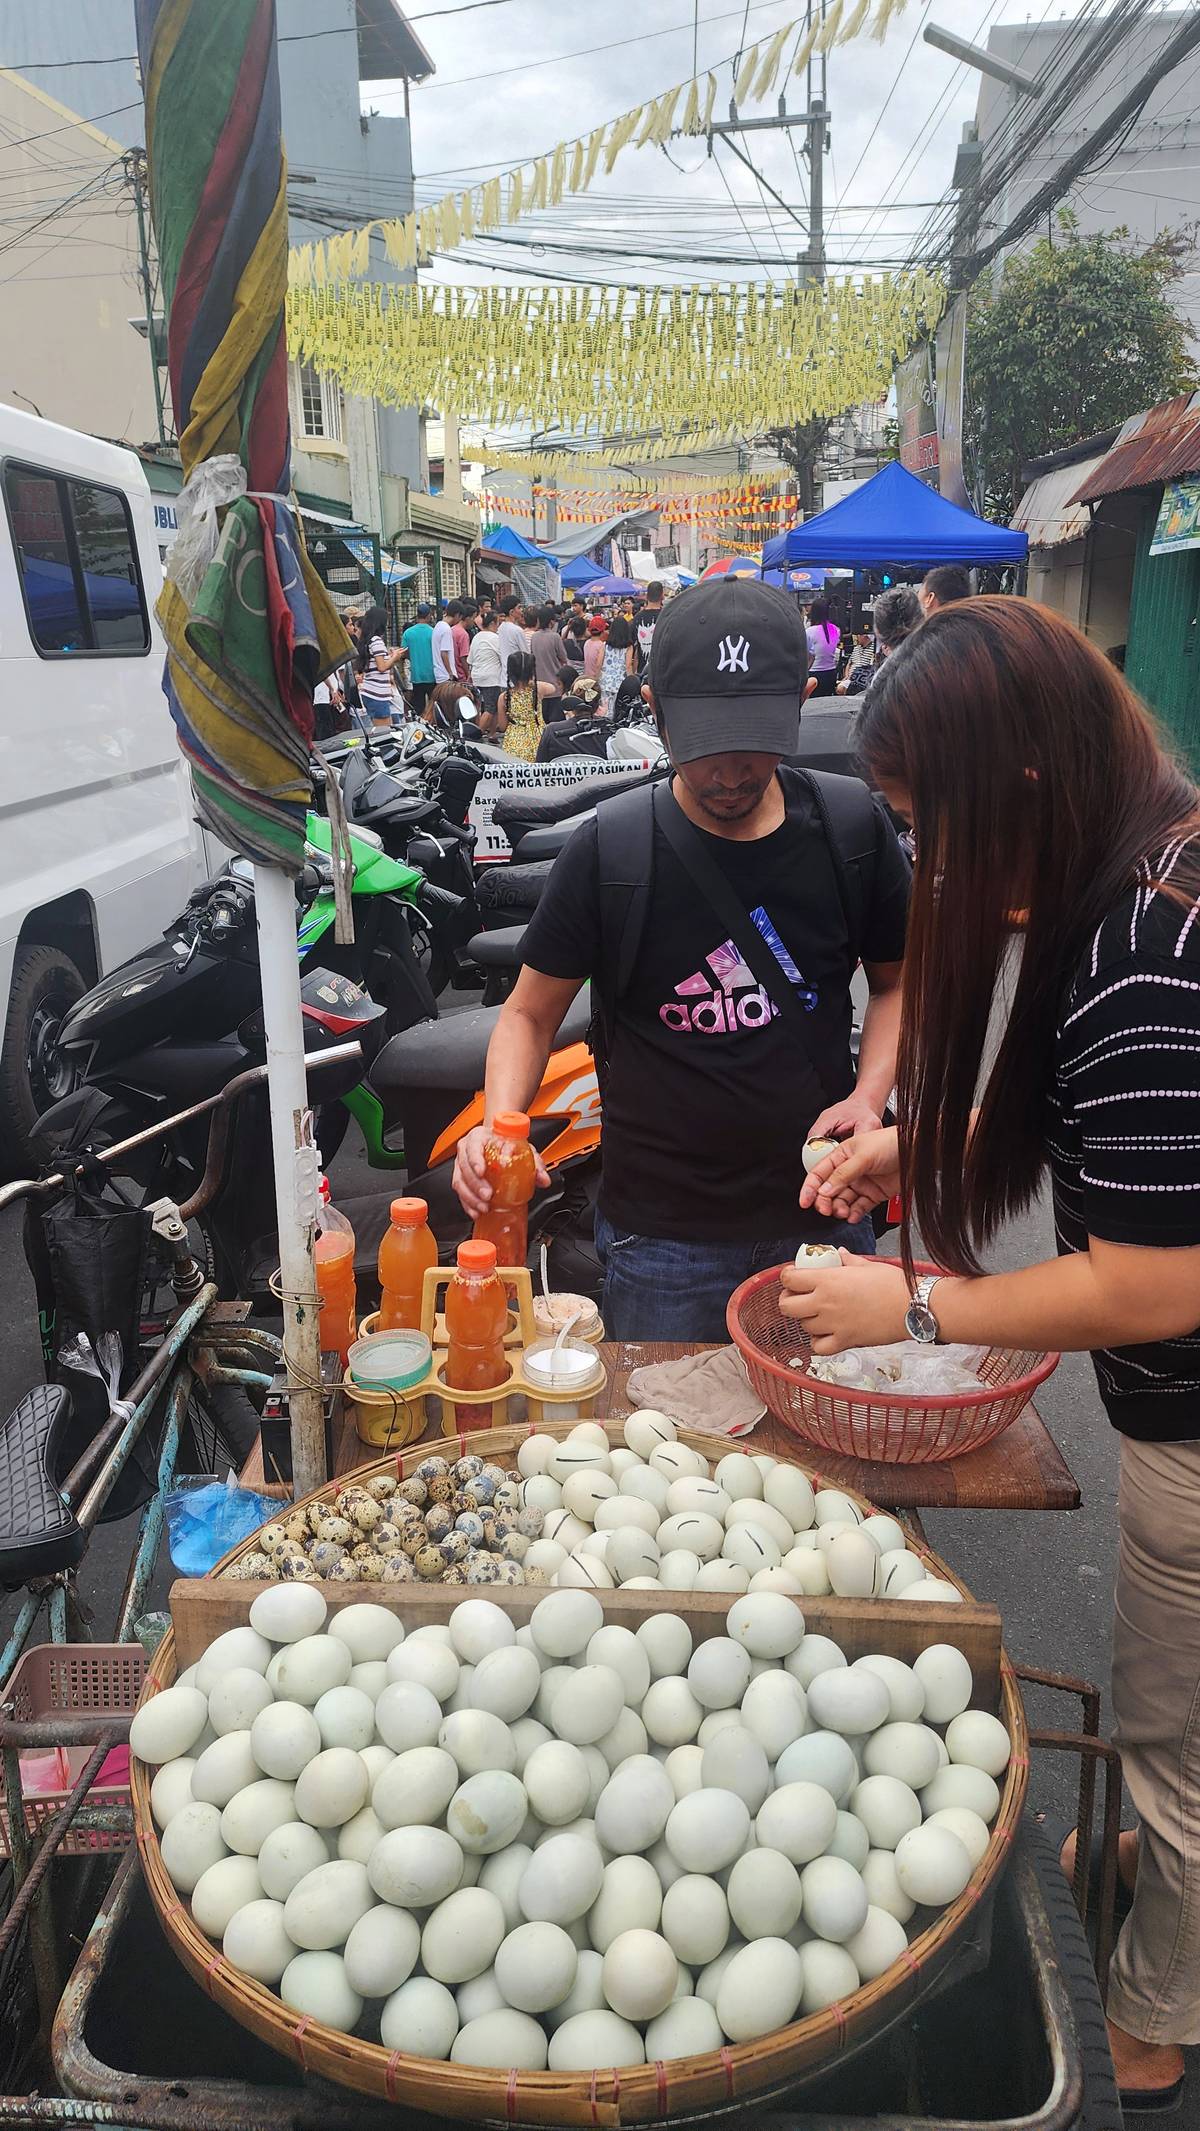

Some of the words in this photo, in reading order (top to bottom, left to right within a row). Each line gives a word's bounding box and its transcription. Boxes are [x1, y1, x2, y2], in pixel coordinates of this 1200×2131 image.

[357, 298, 365, 330] CAUTION
[716, 634, 751, 673] NY
[484, 770, 513, 780] ORAS
[516, 769, 531, 779] NG
[533, 767, 572, 777] UWIAN
[575, 766, 588, 776] AT
[499, 780, 513, 789] NG
[516, 779, 541, 788] MGA
